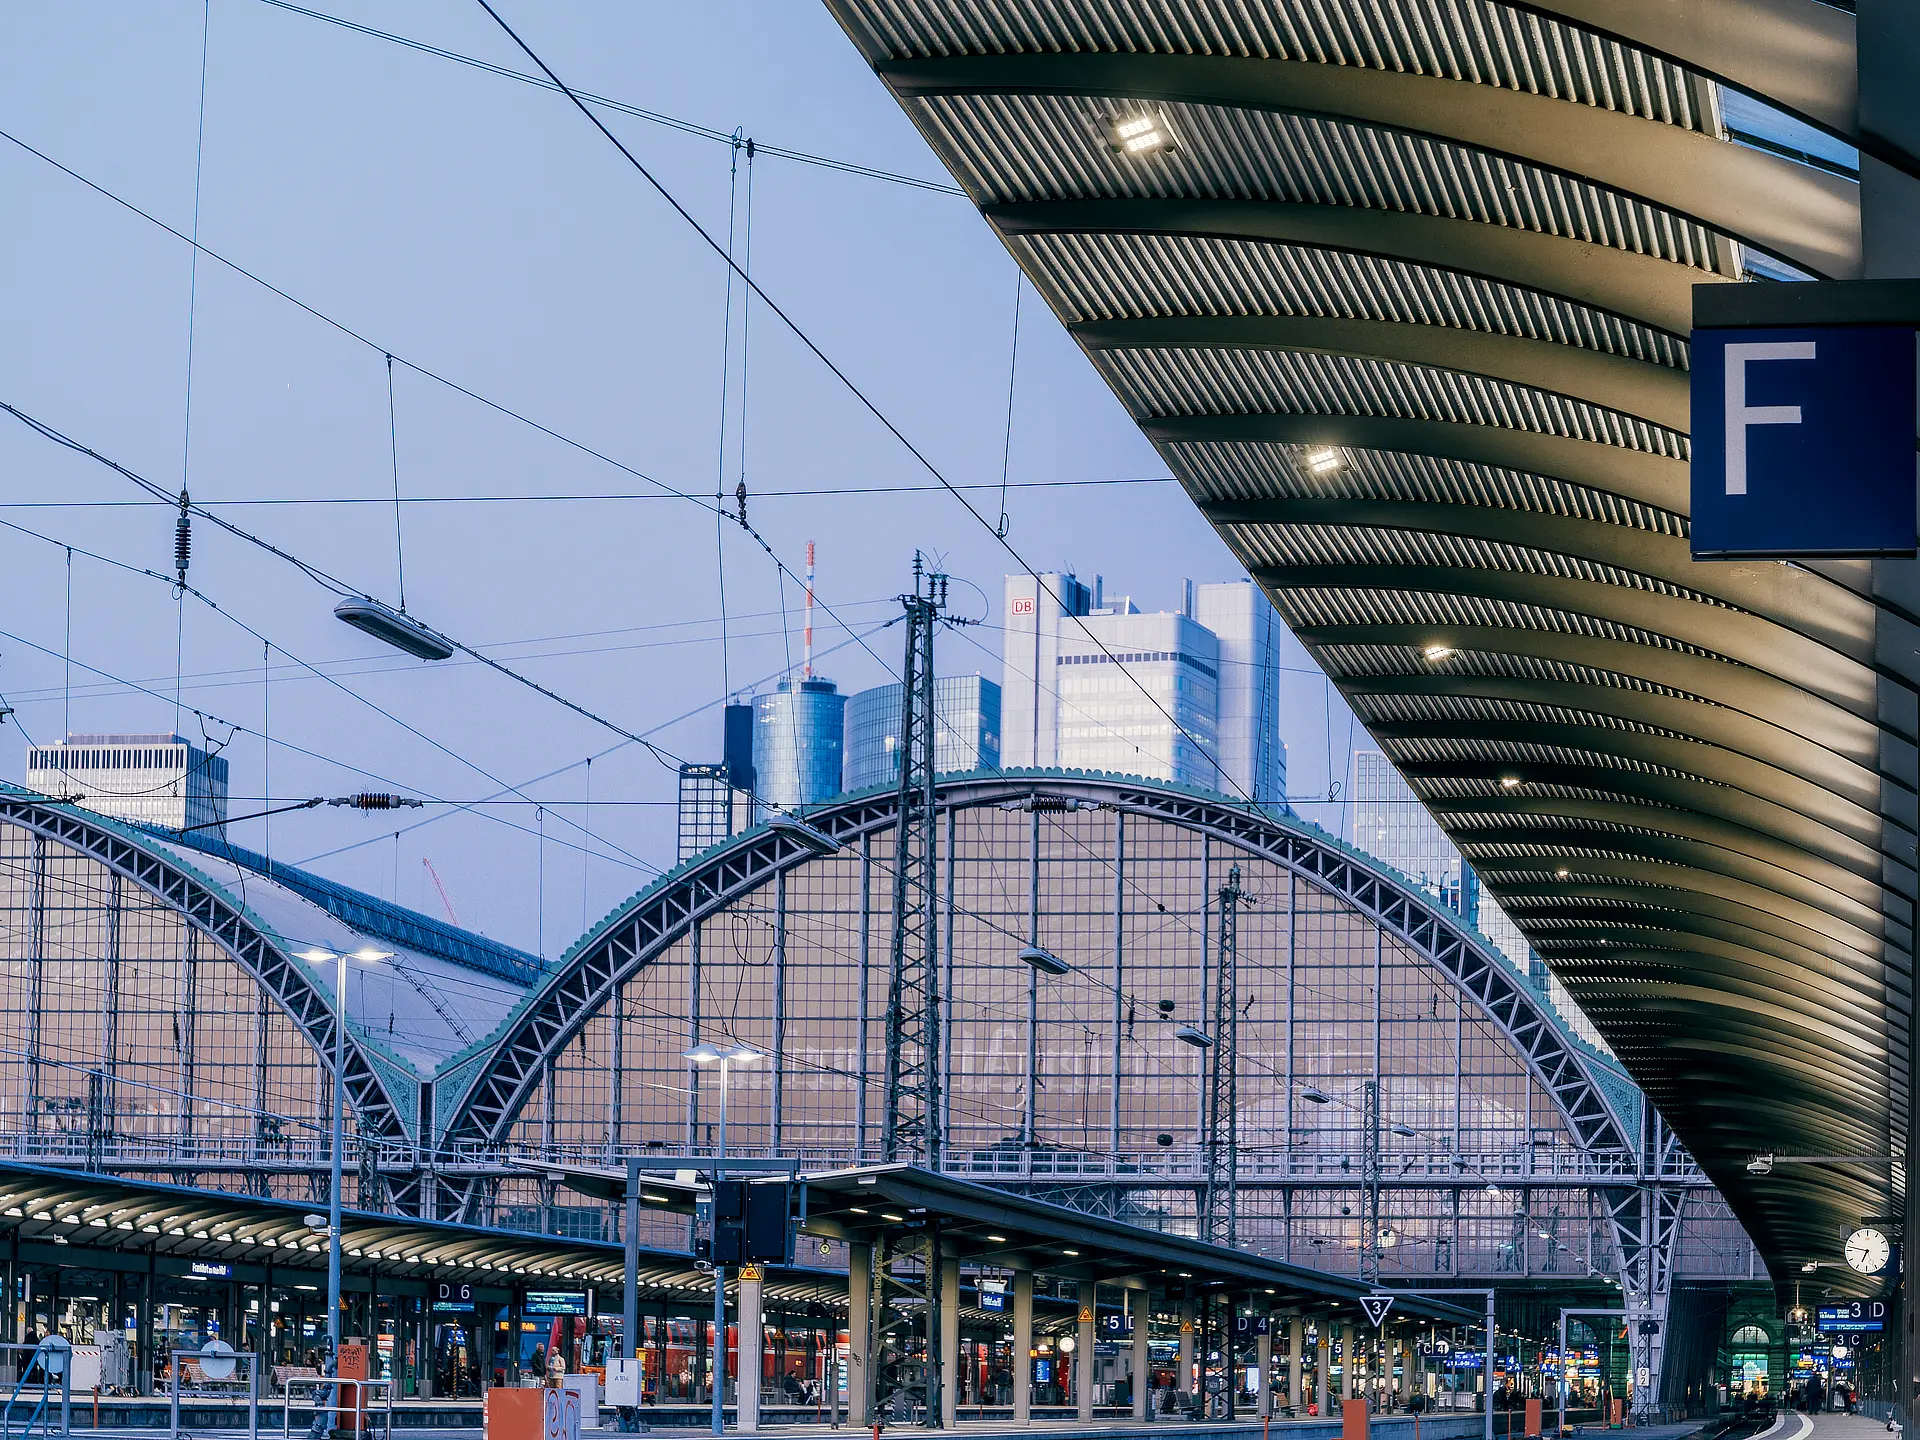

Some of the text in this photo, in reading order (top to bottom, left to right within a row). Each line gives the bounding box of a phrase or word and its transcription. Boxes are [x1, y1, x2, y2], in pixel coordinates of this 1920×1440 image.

[1724, 341, 1817, 496] F
[1015, 601, 1031, 613] DB
[439, 1283, 470, 1300] D 6
[1372, 1301, 1381, 1315] 3
[1851, 1301, 1862, 1318] 3
[1873, 1301, 1885, 1318] D
[1109, 1315, 1120, 1330] 5
[1237, 1317, 1267, 1331] D 4
[1837, 1334, 1860, 1346] 3 C
[1334, 1343, 1342, 1354] 5
[1423, 1344, 1445, 1354] C 4
[1210, 1351, 1219, 1360] B
[1306, 1355, 1312, 1363] 6
[1508, 1355, 1515, 1365] 4
